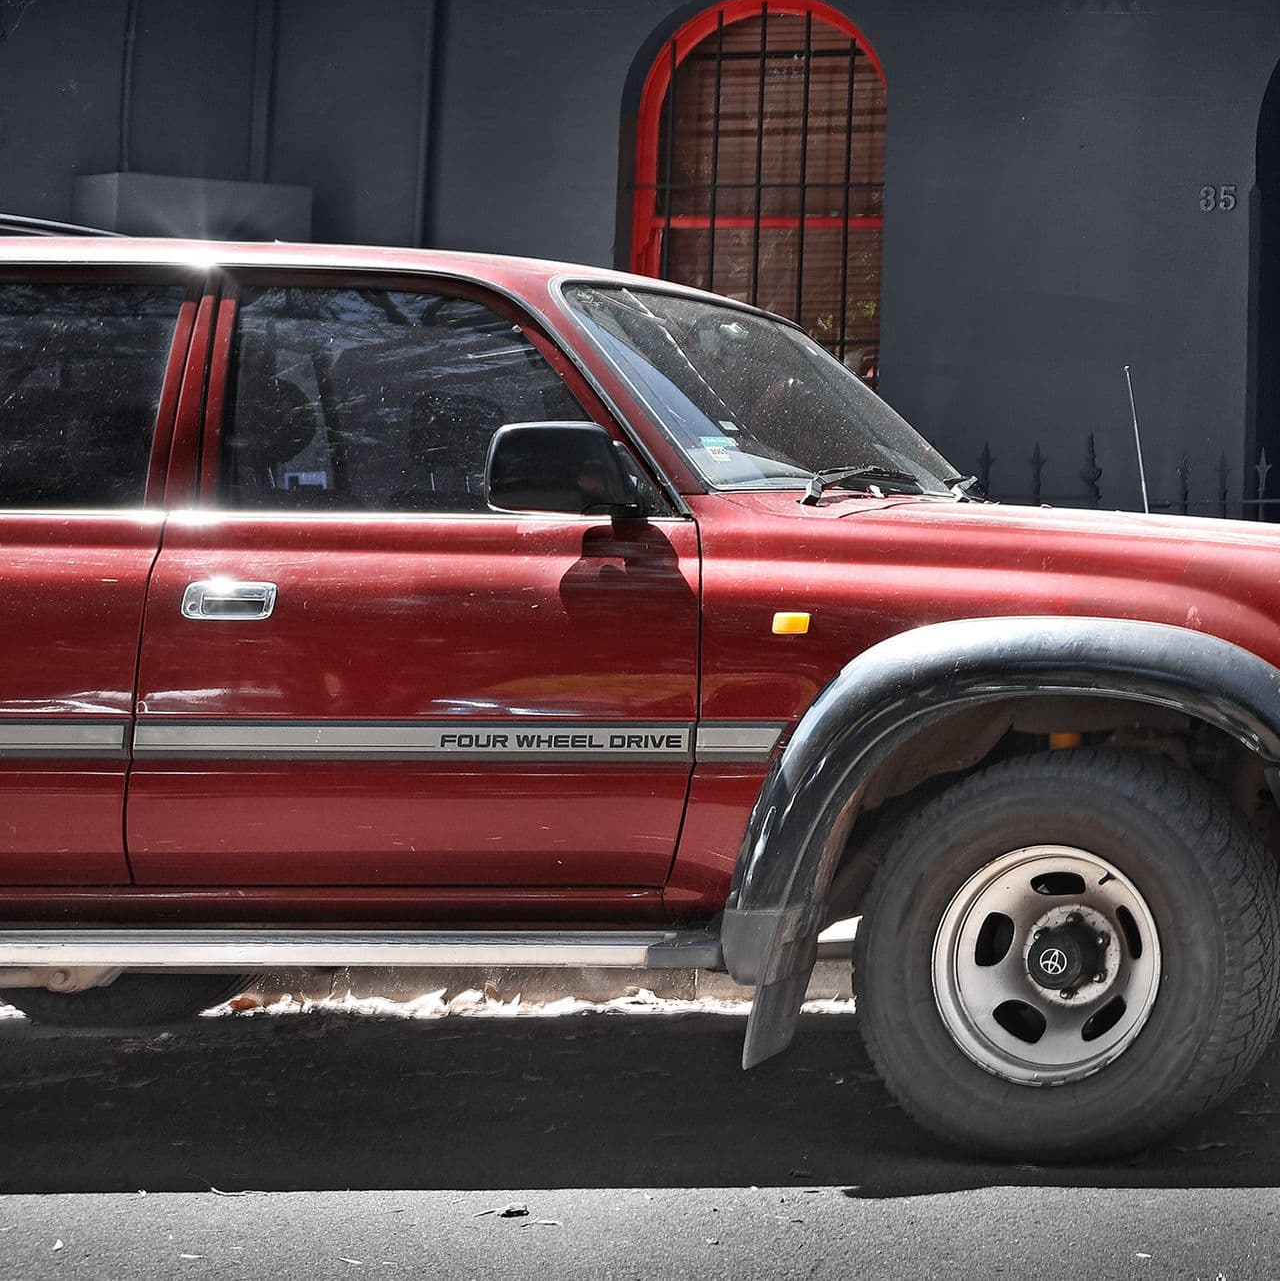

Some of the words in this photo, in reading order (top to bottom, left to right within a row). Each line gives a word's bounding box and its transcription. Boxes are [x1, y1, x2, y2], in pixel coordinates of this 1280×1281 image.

[1200, 185, 1236, 212] 35
[439, 734, 508, 748] FOUR
[516, 734, 604, 748] WHEEL
[609, 734, 682, 748] DRIVE
